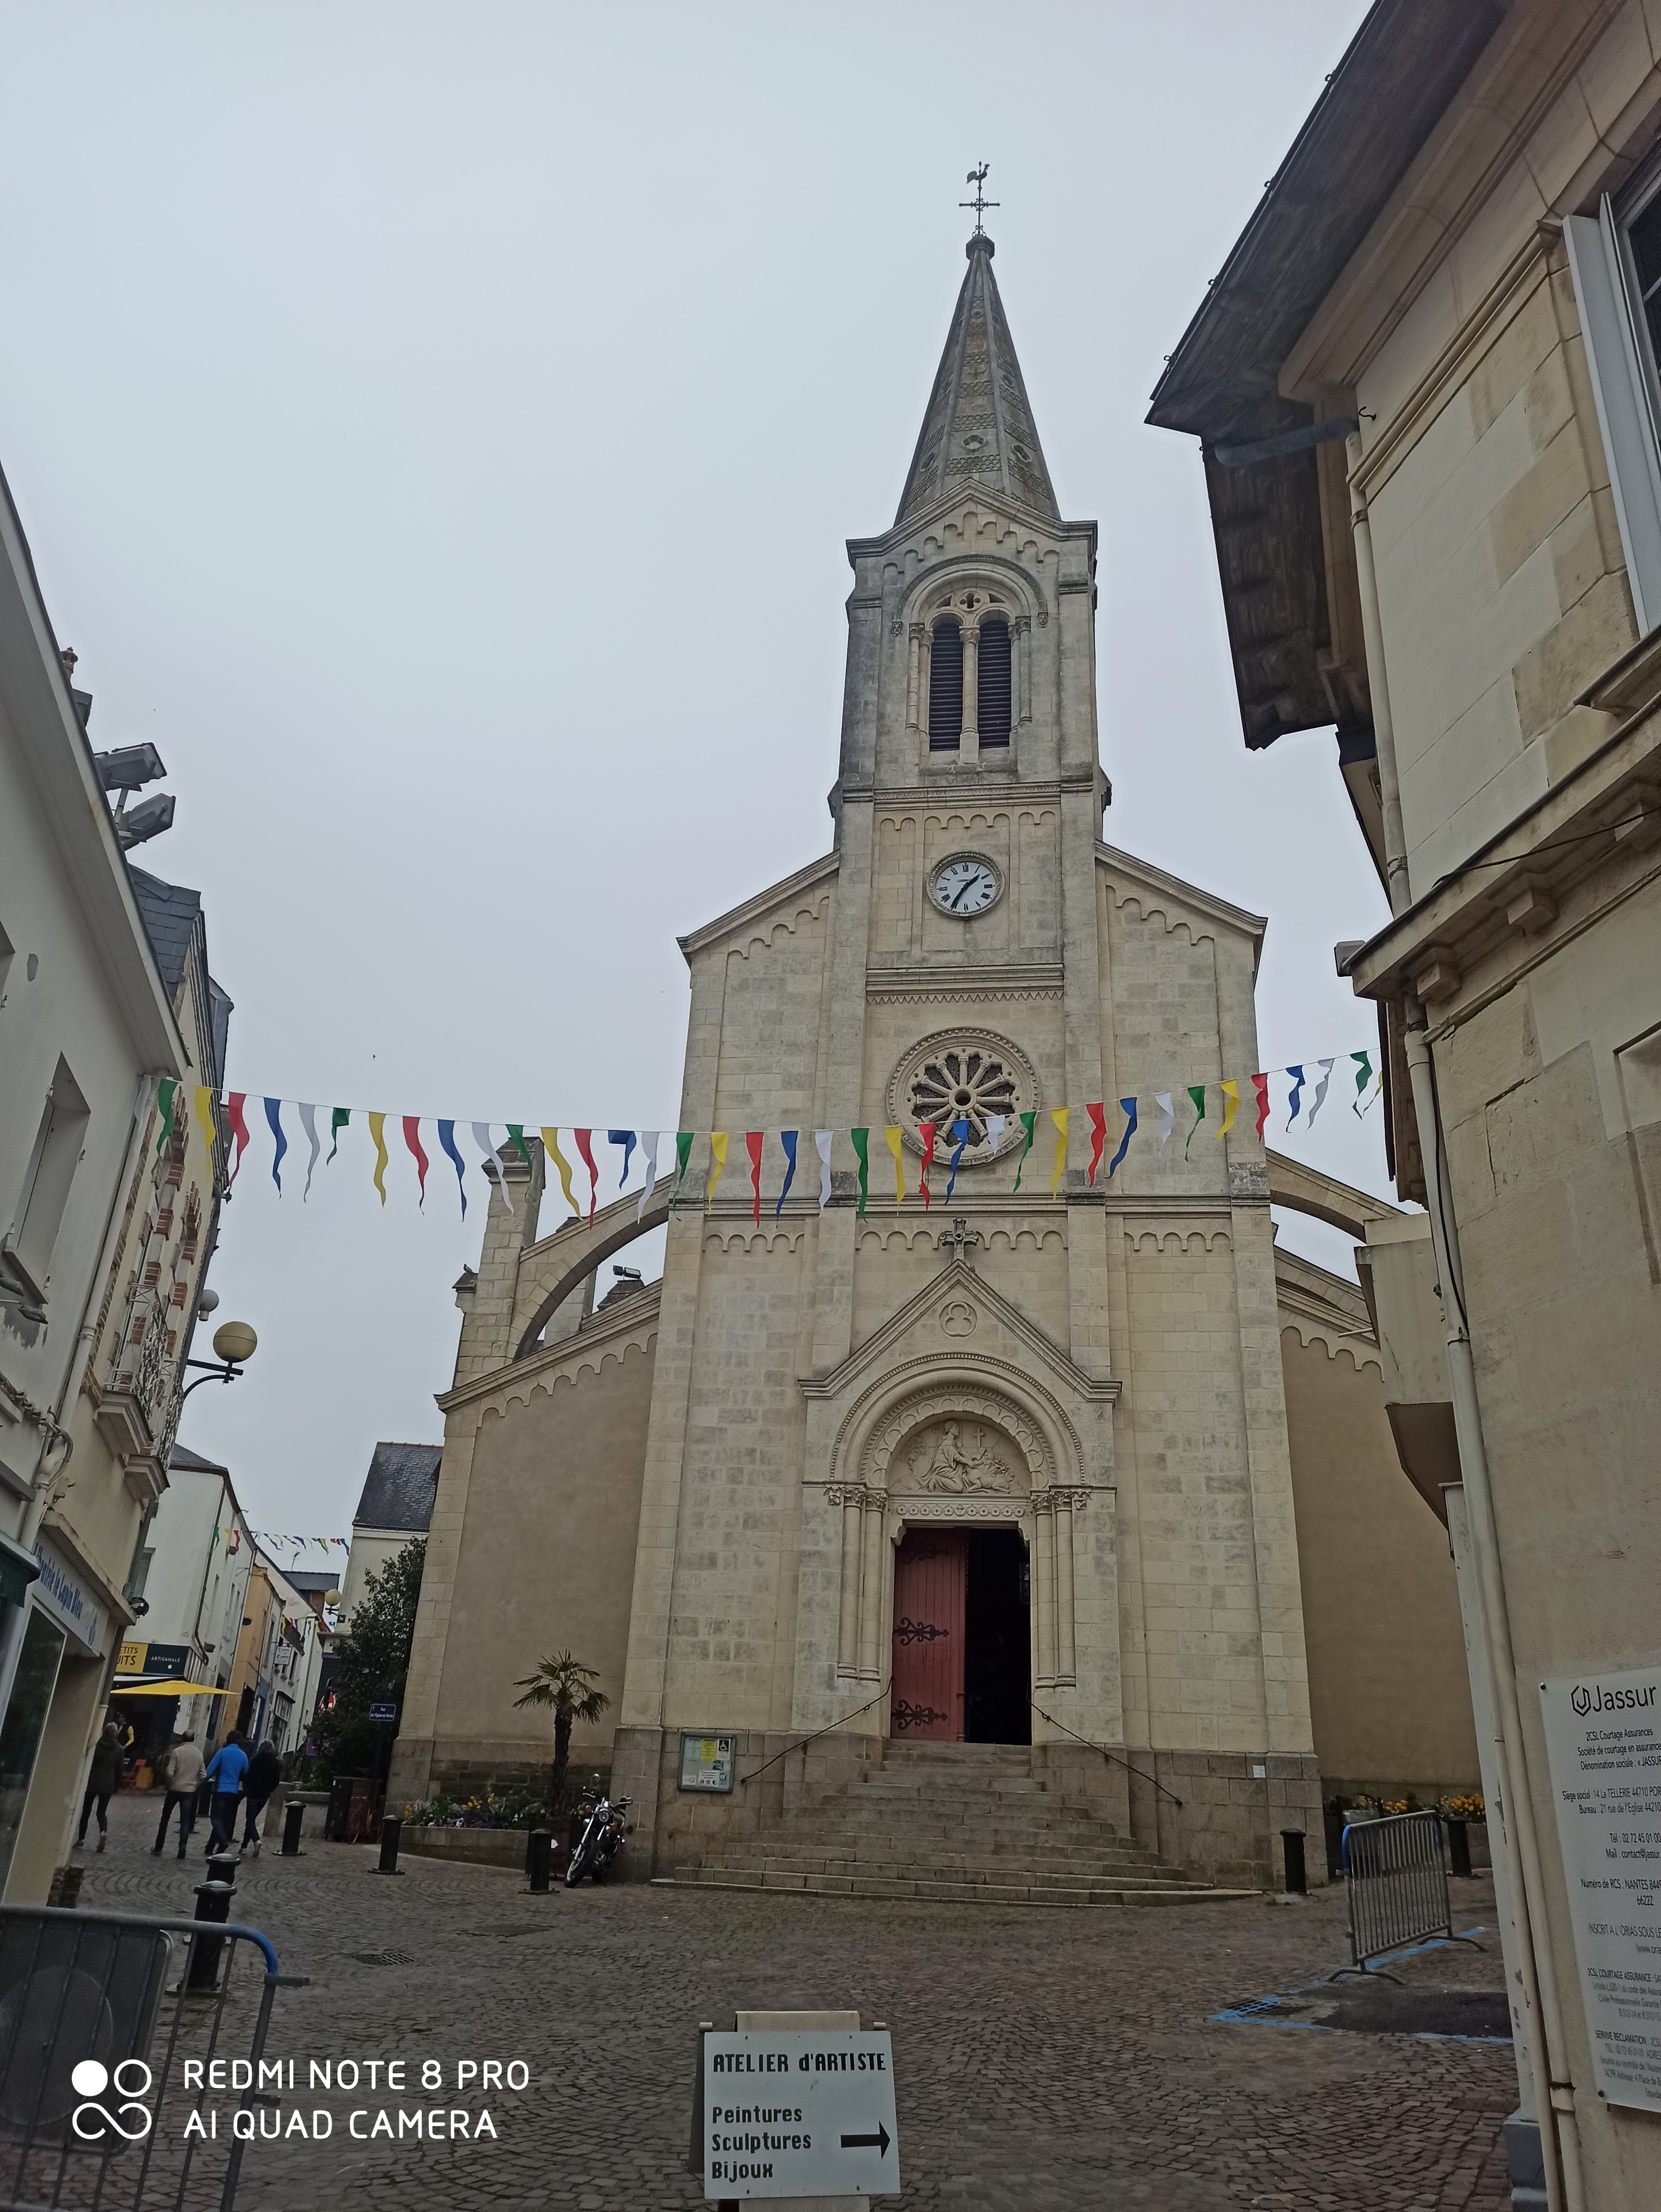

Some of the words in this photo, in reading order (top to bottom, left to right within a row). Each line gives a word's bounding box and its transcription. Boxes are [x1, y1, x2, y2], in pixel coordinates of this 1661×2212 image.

[1593, 1685, 1656, 1712] Jassur
[1586, 1731, 1599, 1741] 2CSL
[1599, 1730, 1623, 1741] Courtage
[1624, 1728, 1653, 1738] Assurances
[1597, 1746, 1604, 1755] de
[1605, 1745, 1627, 1755] courtage
[1628, 1744, 1635, 1752] en
[1616, 1758, 1633, 1768] sociale
[1577, 1789, 1591, 1799] social
[1632, 1787, 1648, 1797] 44710
[1649, 1786, 1661, 1797] POR
[1579, 1804, 1596, 1814] Bureau
[1600, 1803, 1606, 1814] 21
[1617, 1804, 1624, 1813] de
[1645, 1802, 1661, 1812] 44210
[1622, 1833, 1629, 1843] 02
[1629, 1833, 1637, 1843] 72
[1638, 1833, 1645, 1843] 45
[1646, 1833, 1652, 1843] 01
[1653, 1833, 1661, 1843] 00
[1581, 1878, 1601, 1888] Numéro
[1603, 1878, 1609, 1889] de
[1610, 1879, 1621, 1889] RCS
[1625, 1879, 1648, 1890] NANTES
[1620, 1924, 1638, 1937] ORIAS
[1638, 1926, 1654, 1938] SOUS
[1599, 1969, 1623, 1980] COURTAGE
[1624, 1971, 1651, 1982] ASSURANCE
[713, 2054, 789, 2073] ATELIER
[798, 2053, 886, 2072] d'ARTISTE
[712, 2106, 802, 2124] Peintures
[712, 2132, 812, 2154] Sculptures
[712, 2161, 773, 2183] Bijoux
